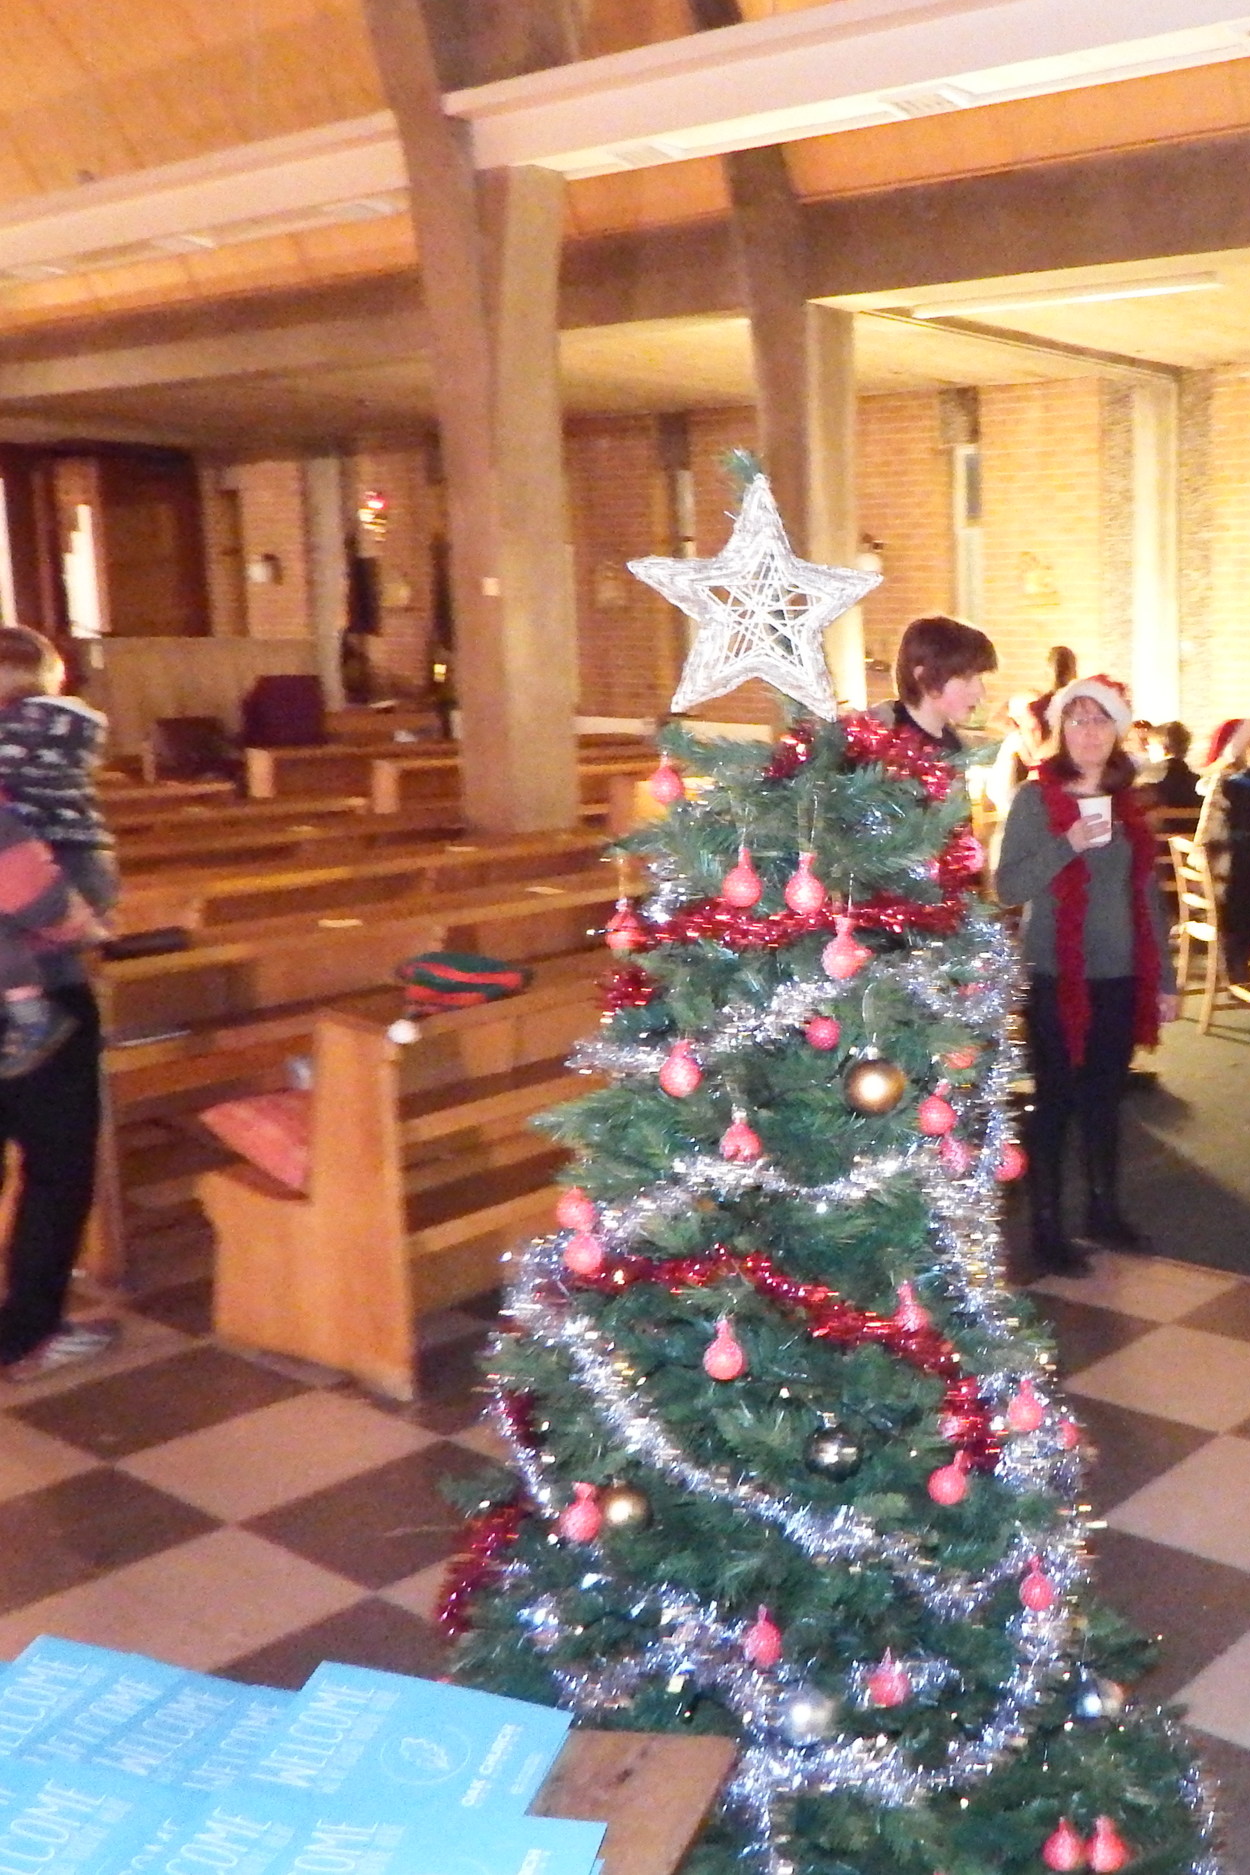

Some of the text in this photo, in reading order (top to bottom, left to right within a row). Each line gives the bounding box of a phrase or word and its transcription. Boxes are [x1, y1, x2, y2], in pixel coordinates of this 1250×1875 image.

[91, 1687, 236, 1777] WELCOME
[251, 1679, 374, 1788] WELCOME
[289, 1818, 379, 1875] OME
